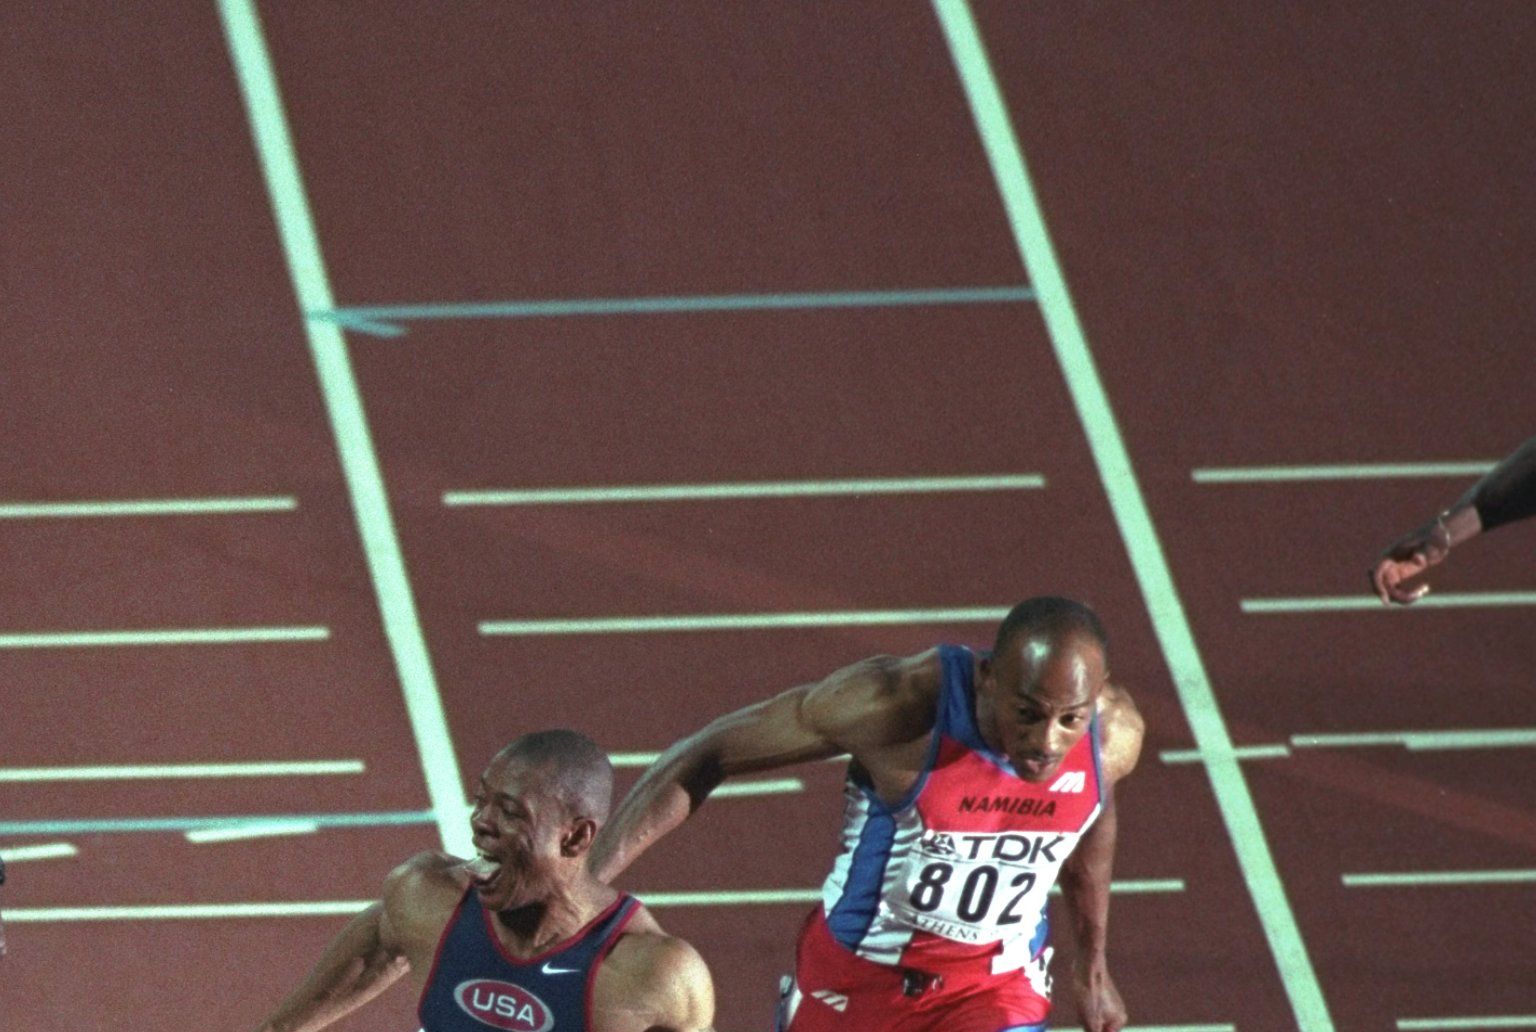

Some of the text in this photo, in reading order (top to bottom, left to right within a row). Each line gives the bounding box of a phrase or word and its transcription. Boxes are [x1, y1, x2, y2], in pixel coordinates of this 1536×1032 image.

[959, 796, 1057, 818] NAMIBIA
[962, 835, 1065, 864] TDK
[909, 862, 1037, 926] 802
[911, 913, 980, 942] THENS
[472, 987, 535, 1028] USA
